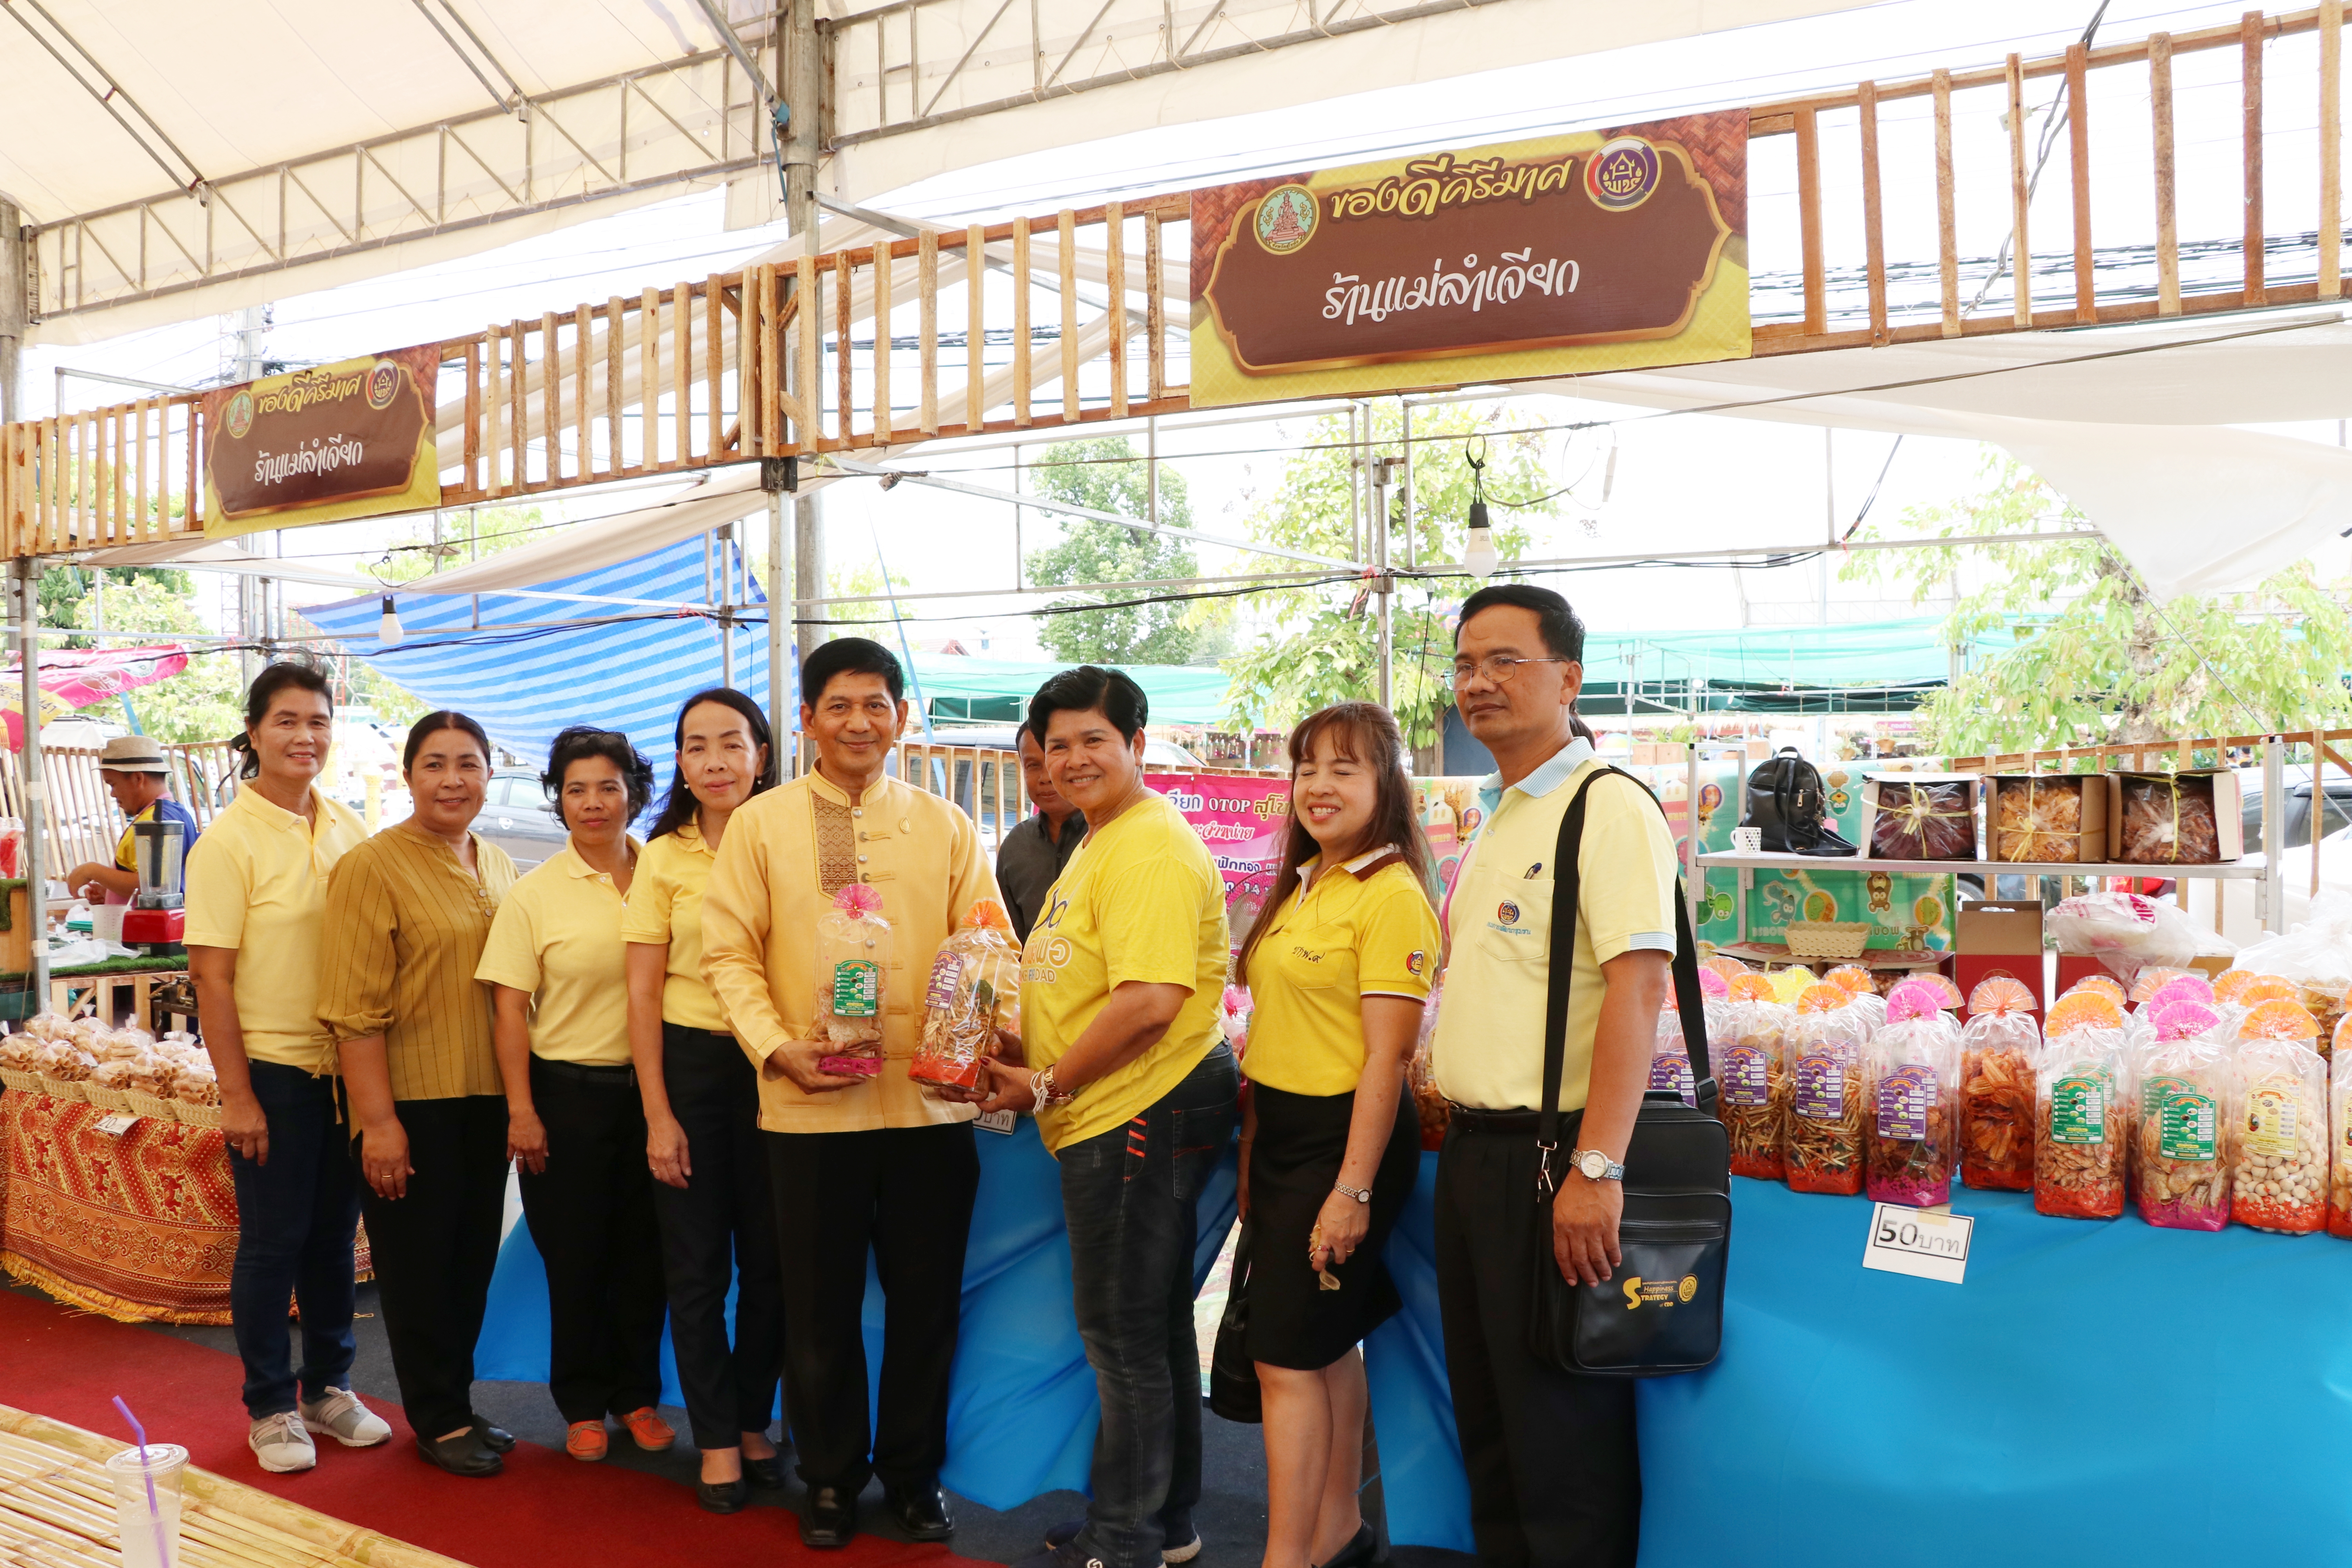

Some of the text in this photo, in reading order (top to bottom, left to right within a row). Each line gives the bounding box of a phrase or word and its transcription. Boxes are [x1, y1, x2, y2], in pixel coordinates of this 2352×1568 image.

[1331, 154, 1573, 218] ของดีคีรีมาศ
[1322, 247, 1580, 325] ร้านแม่ลำเจียก
[258, 371, 362, 414] ของดีคีรีมาศ
[254, 433, 363, 486] ร้านแม่ลำเจียก
[1209, 797, 1250, 813] OTOP
[1218, 856, 1260, 871] ฟักทอง
[1643, 1285, 1674, 1294] Happiness
